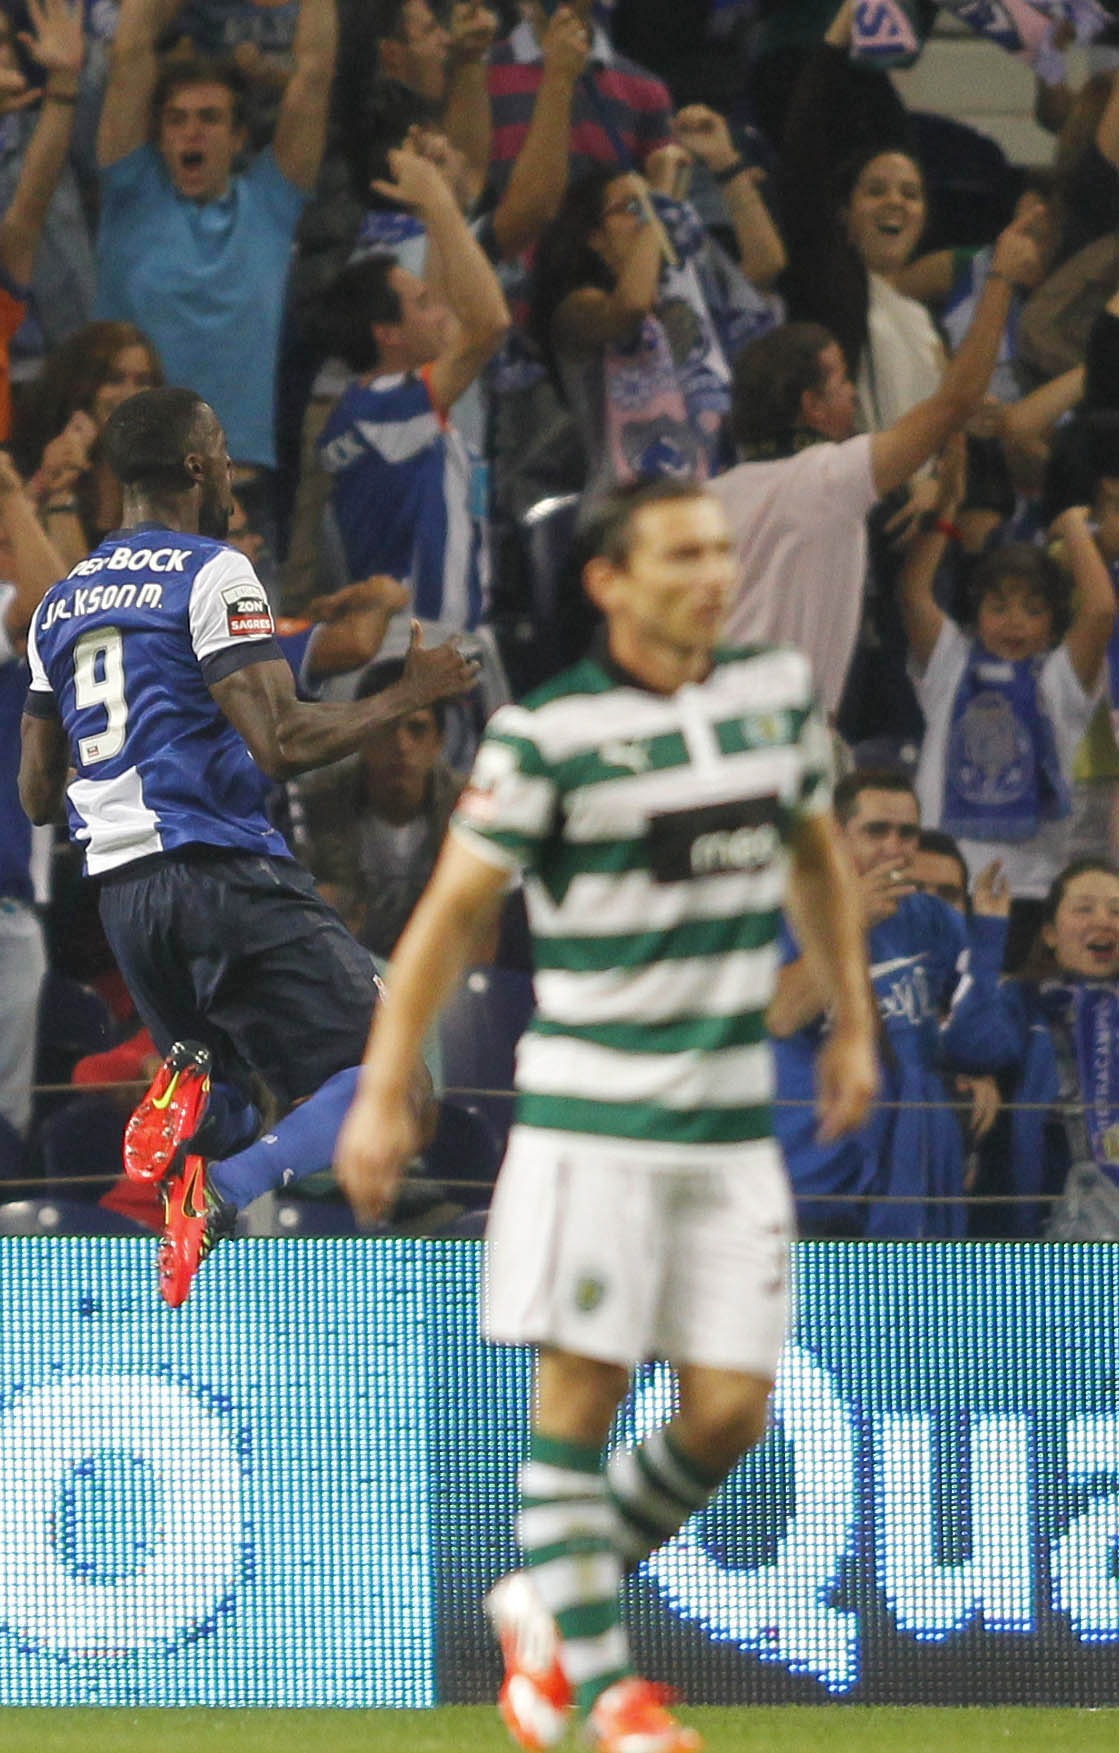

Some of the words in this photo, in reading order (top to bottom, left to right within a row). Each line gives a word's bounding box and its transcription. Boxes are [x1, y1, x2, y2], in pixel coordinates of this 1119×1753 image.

[108, 547, 193, 573] BOCK
[41, 583, 137, 630] JAKSON
[236, 600, 264, 613] ZON
[230, 618, 271, 631] SAGRES
[73, 626, 129, 766] 9
